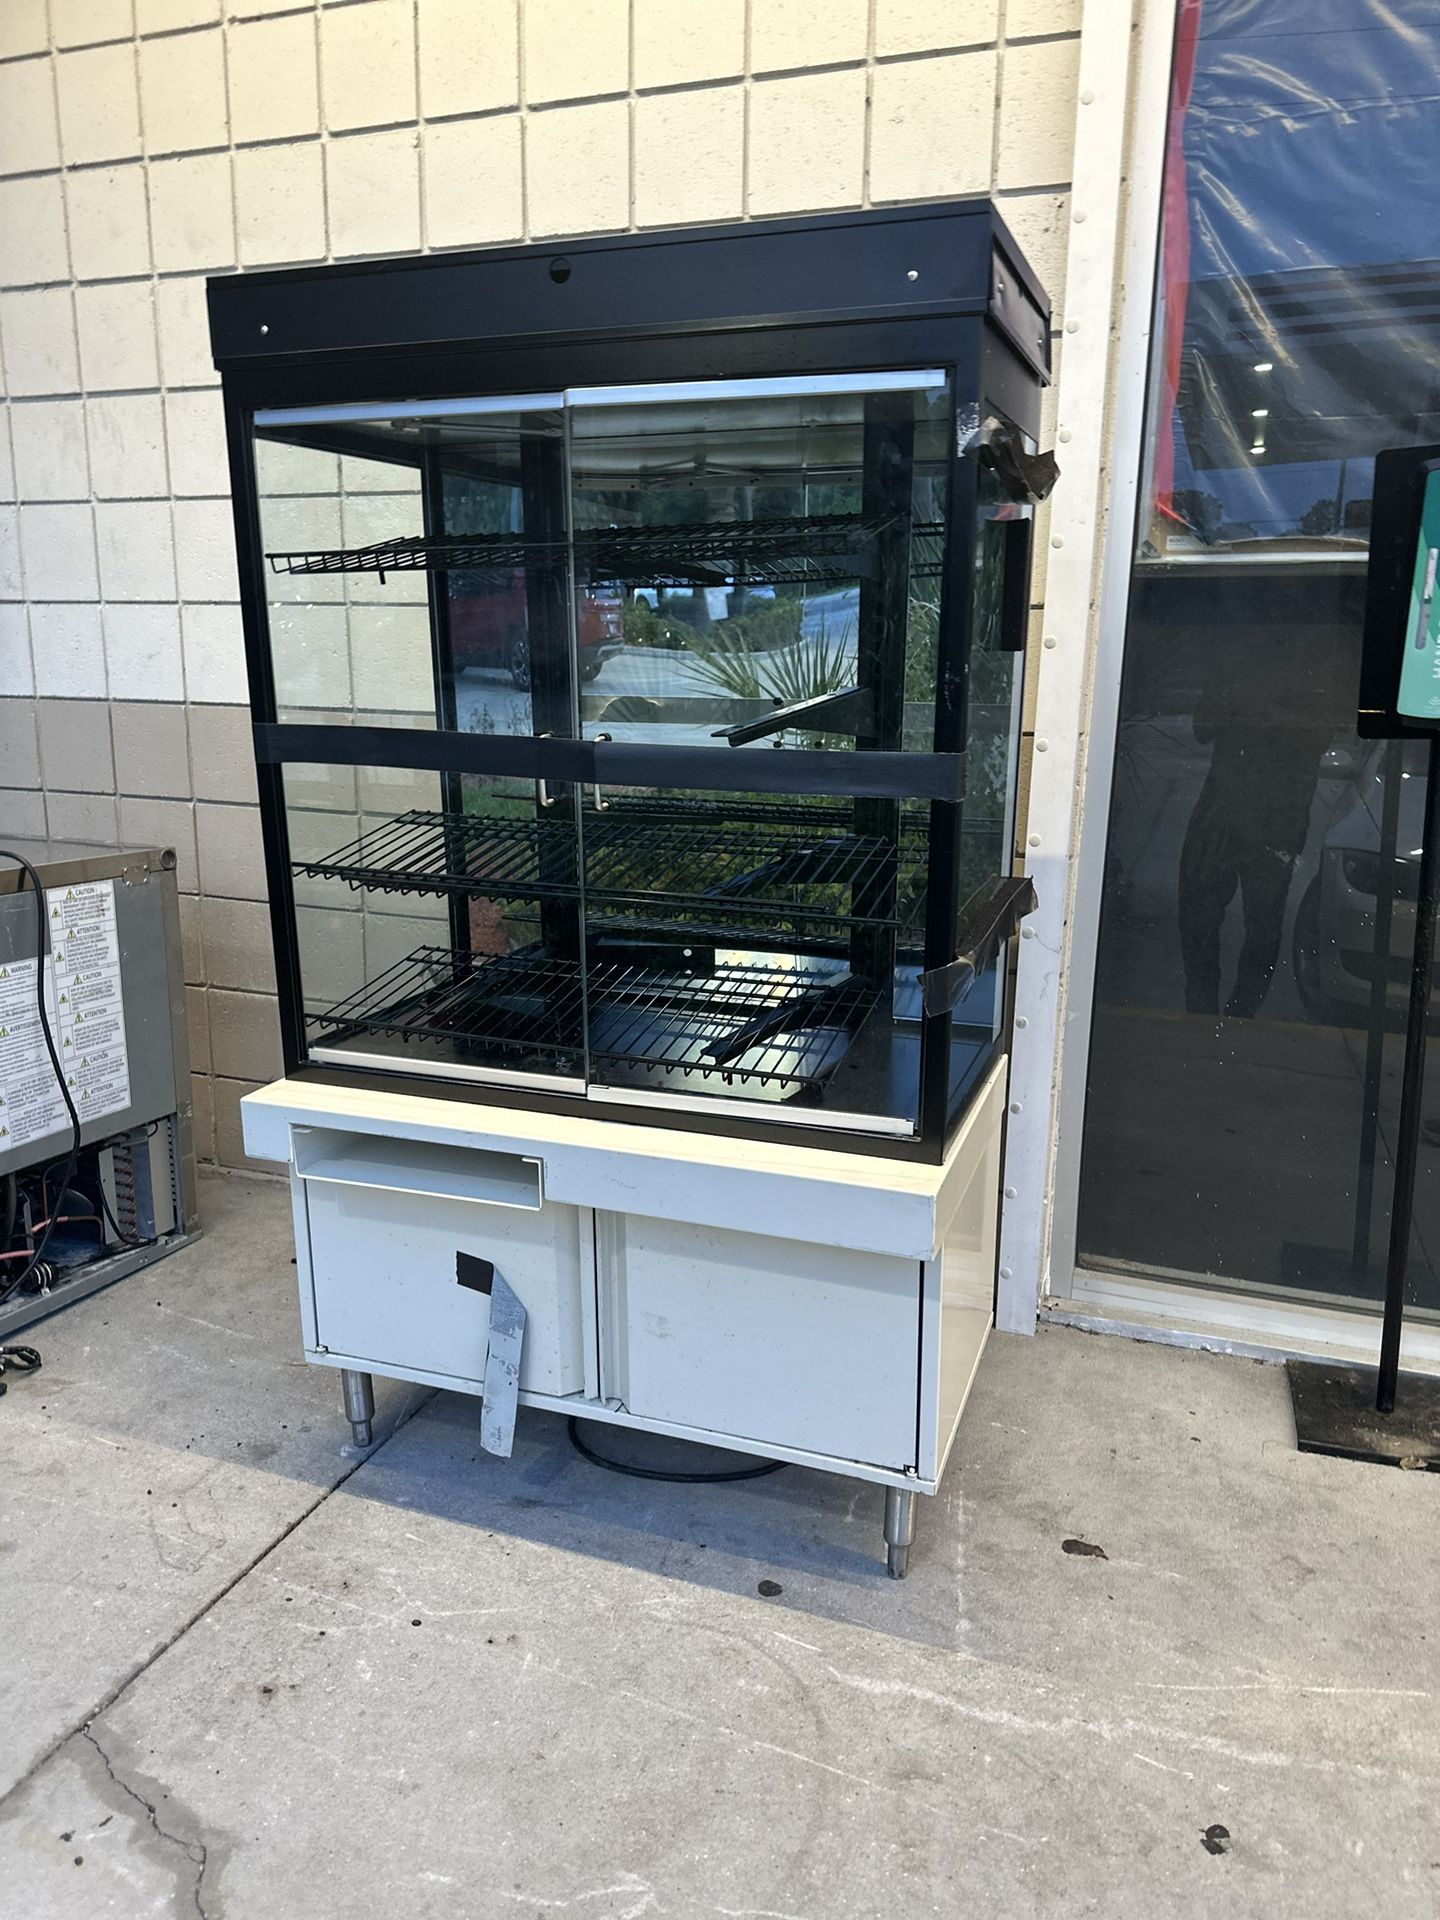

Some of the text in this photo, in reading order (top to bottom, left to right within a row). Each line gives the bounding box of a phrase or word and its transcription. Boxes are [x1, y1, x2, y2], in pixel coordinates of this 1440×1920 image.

[75, 888, 95, 896] CAUTION
[77, 925, 101, 934] ATTENTION
[83, 971, 102, 981] CAUTION
[84, 1008, 107, 1018] ATTENTION
[10, 1020, 41, 1032] AVERTISSEMEN
[91, 1082, 113, 1094] ATTENTION
